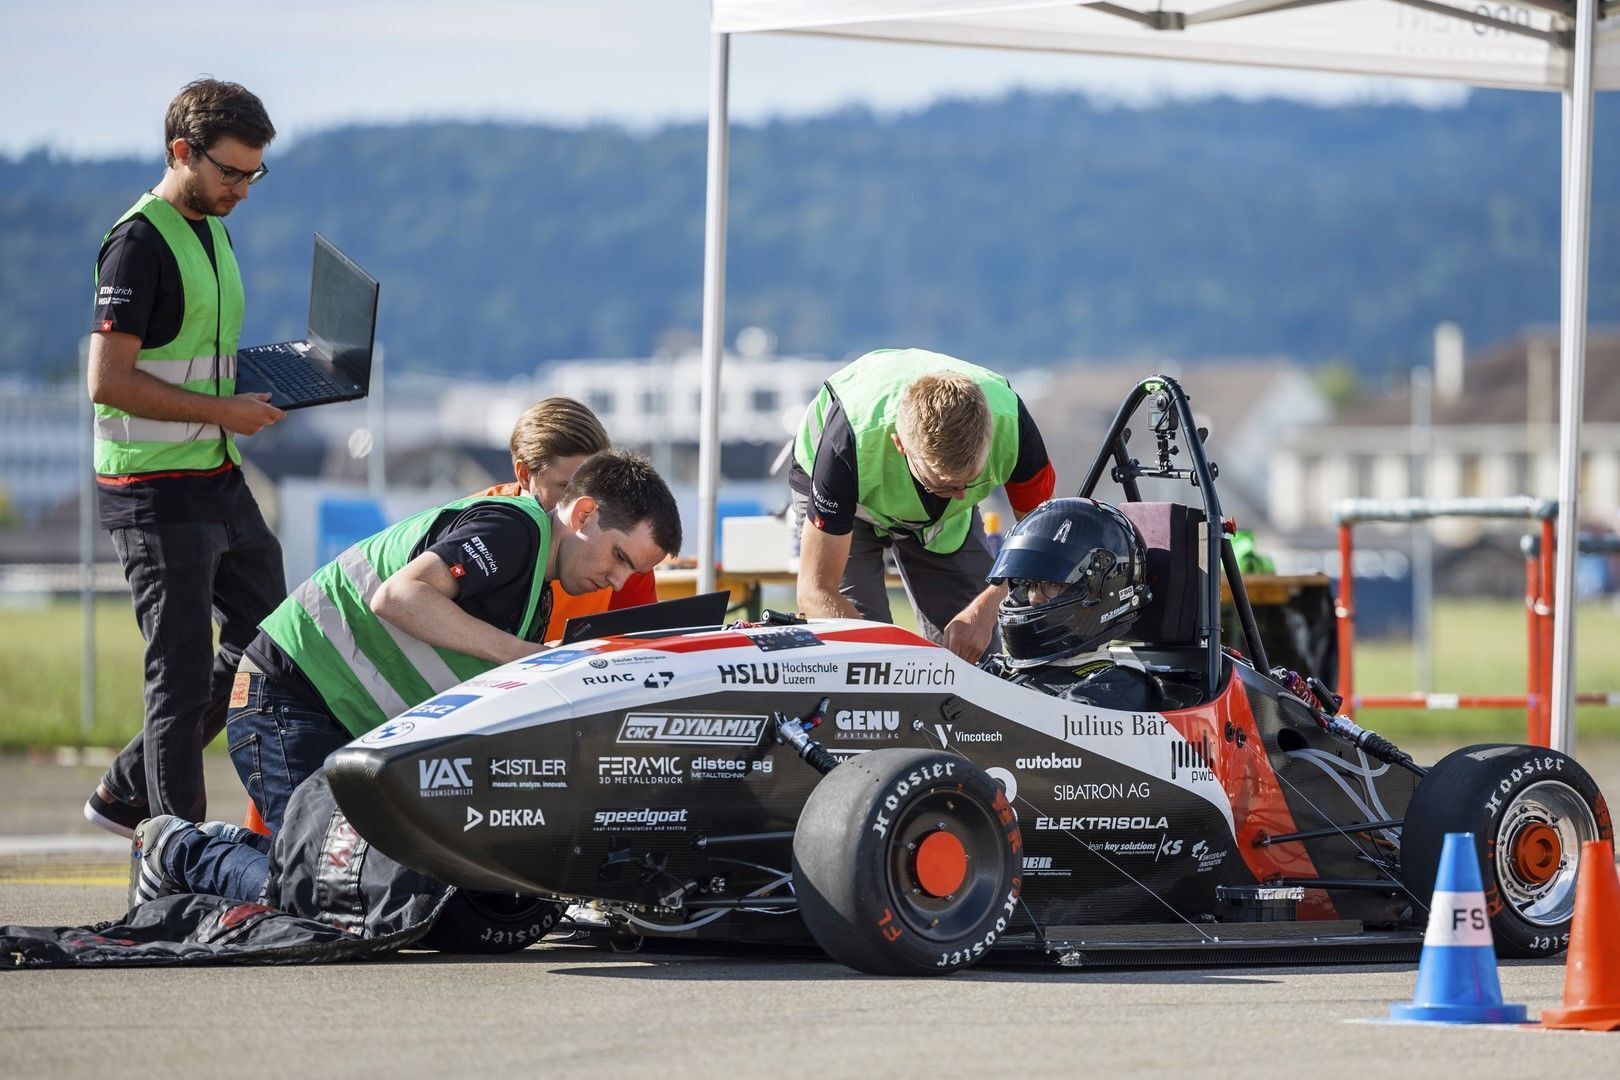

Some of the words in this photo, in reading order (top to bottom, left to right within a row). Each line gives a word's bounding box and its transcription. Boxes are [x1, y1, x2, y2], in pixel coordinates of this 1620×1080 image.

[462, 542, 480, 559] HSLU
[582, 673, 635, 686] RUAG
[717, 663, 779, 685] HSLU
[782, 662, 838, 674] Hochschule
[783, 675, 815, 685] Luzern
[626, 727, 653, 739] CNC
[668, 718, 761, 736] DYNAMIX
[835, 710, 900, 731] GENU
[1063, 715, 1123, 740] Julius
[1132, 715, 1169, 736] Bär
[837, 732, 881, 740] PARTNER
[955, 731, 1003, 742] Vincotech
[489, 759, 567, 776] KISTLER
[598, 756, 683, 776] FERAMIC
[691, 757, 746, 770] distec
[752, 759, 773, 773] ag
[1015, 753, 1082, 769] autobau
[418, 758, 474, 789] VAC
[614, 776, 683, 784] METALLDRUCK
[1191, 768, 1213, 783] pwb
[1054, 784, 1122, 800] SIBATRON
[1127, 782, 1150, 798] AG
[1485, 757, 1564, 817] Hoosier
[873, 762, 955, 840] Hoosier
[489, 809, 545, 827] DEKRA
[594, 808, 688, 826] speedgoat
[1035, 816, 1169, 830] ELEKTRISOLA
[1104, 842, 1121, 852] key
[1121, 842, 1157, 851] solutions
[1452, 909, 1485, 931] FS
[936, 892, 1018, 968] Hoosier
